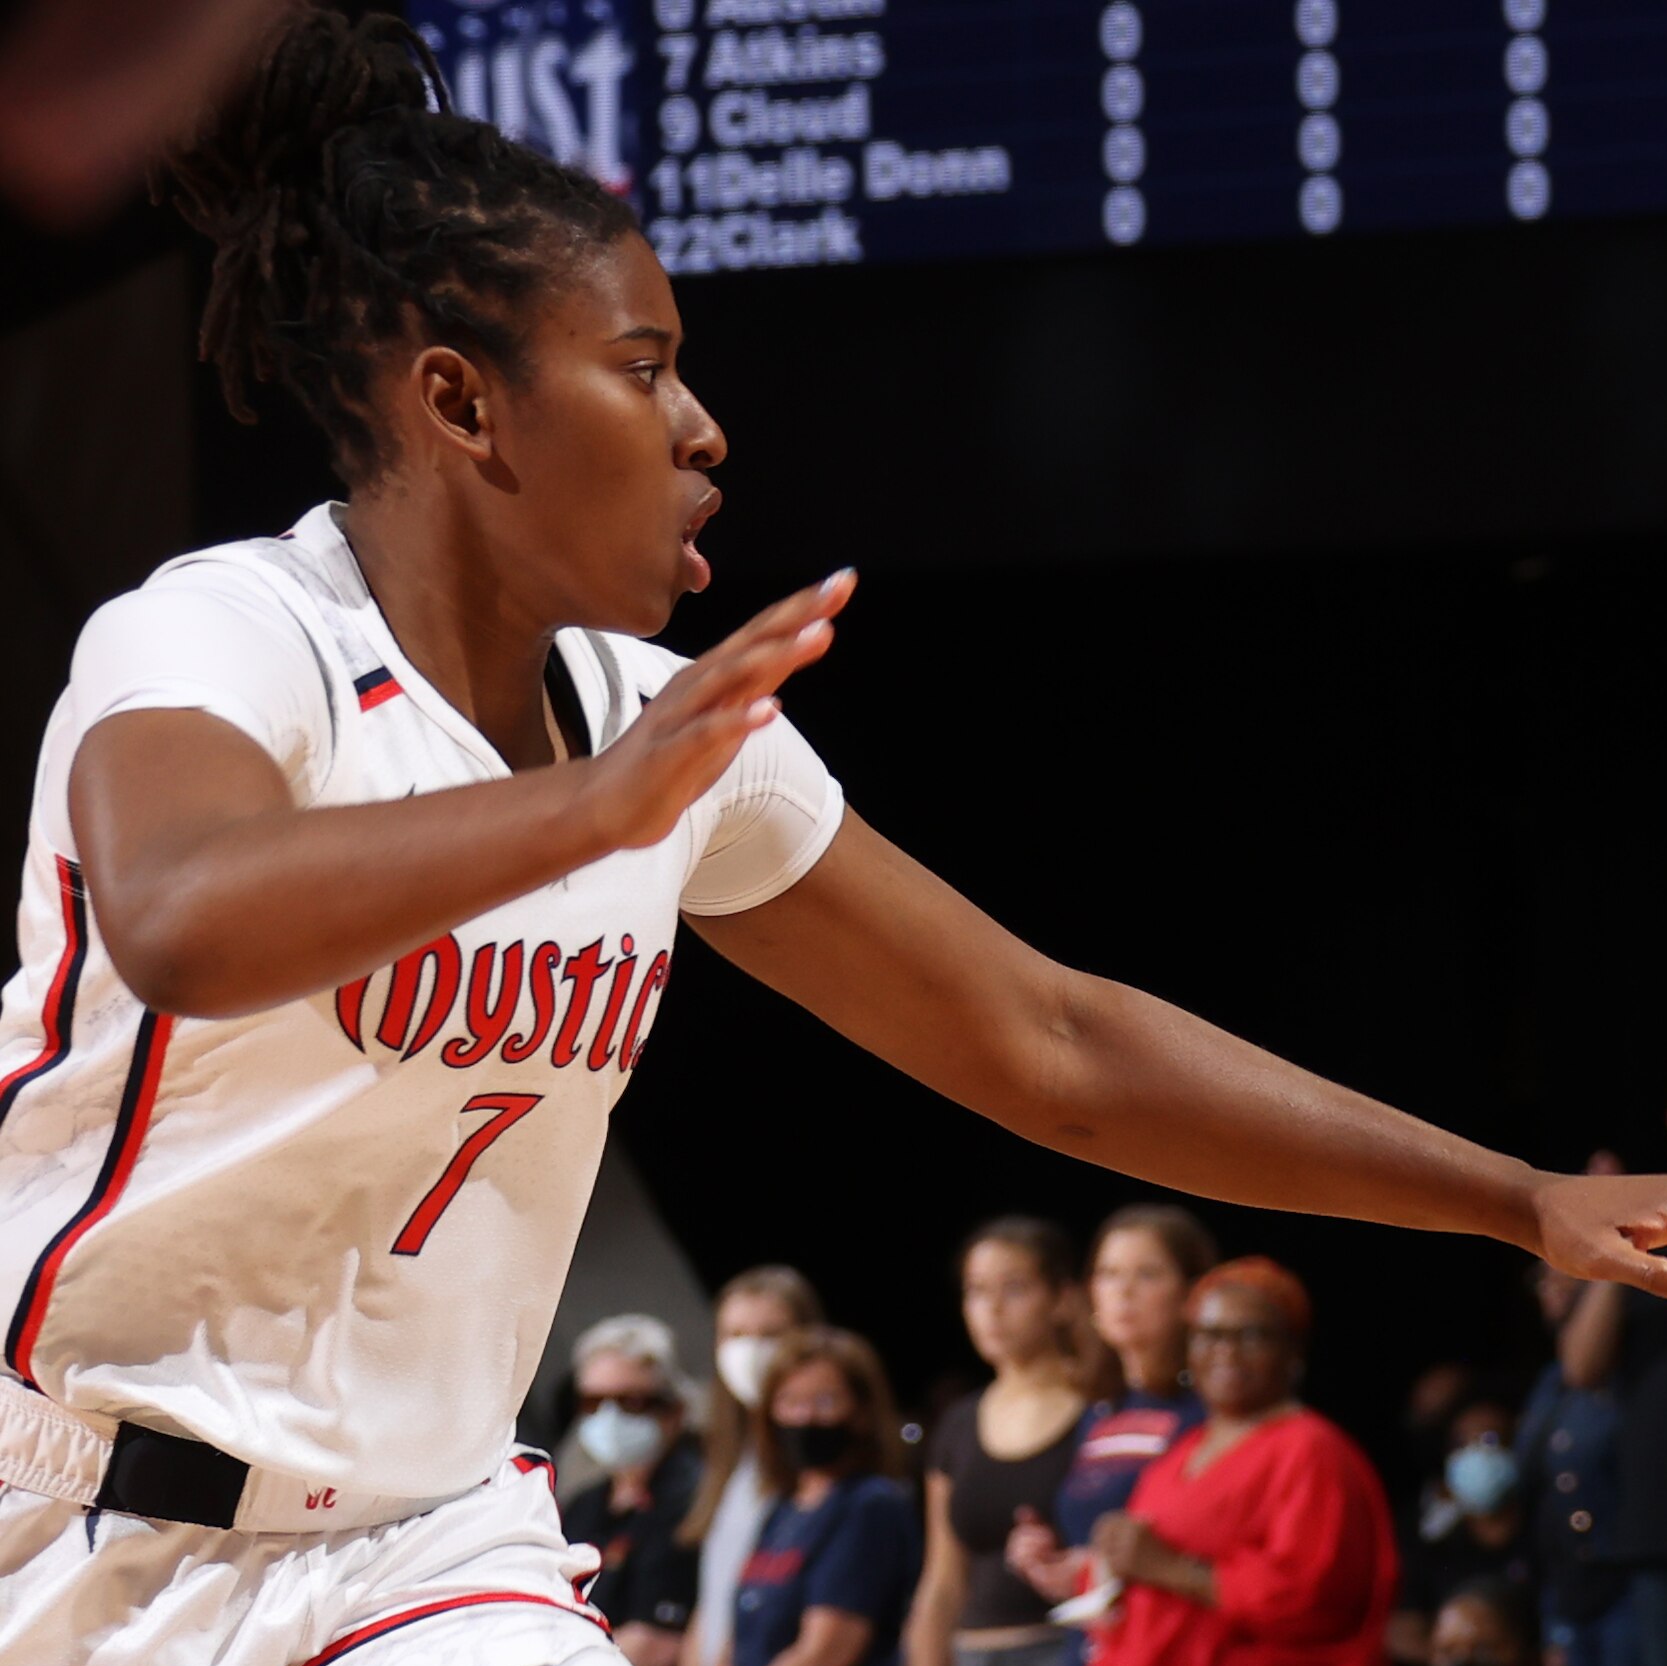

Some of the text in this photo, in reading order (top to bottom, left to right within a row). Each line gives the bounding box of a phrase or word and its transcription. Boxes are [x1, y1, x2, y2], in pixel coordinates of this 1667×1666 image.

[659, 33, 697, 90] 7
[705, 28, 886, 88] Atkins
[659, 95, 700, 153] 9
[708, 86, 871, 149] Cloud
[389, 1091, 545, 1256] 7
